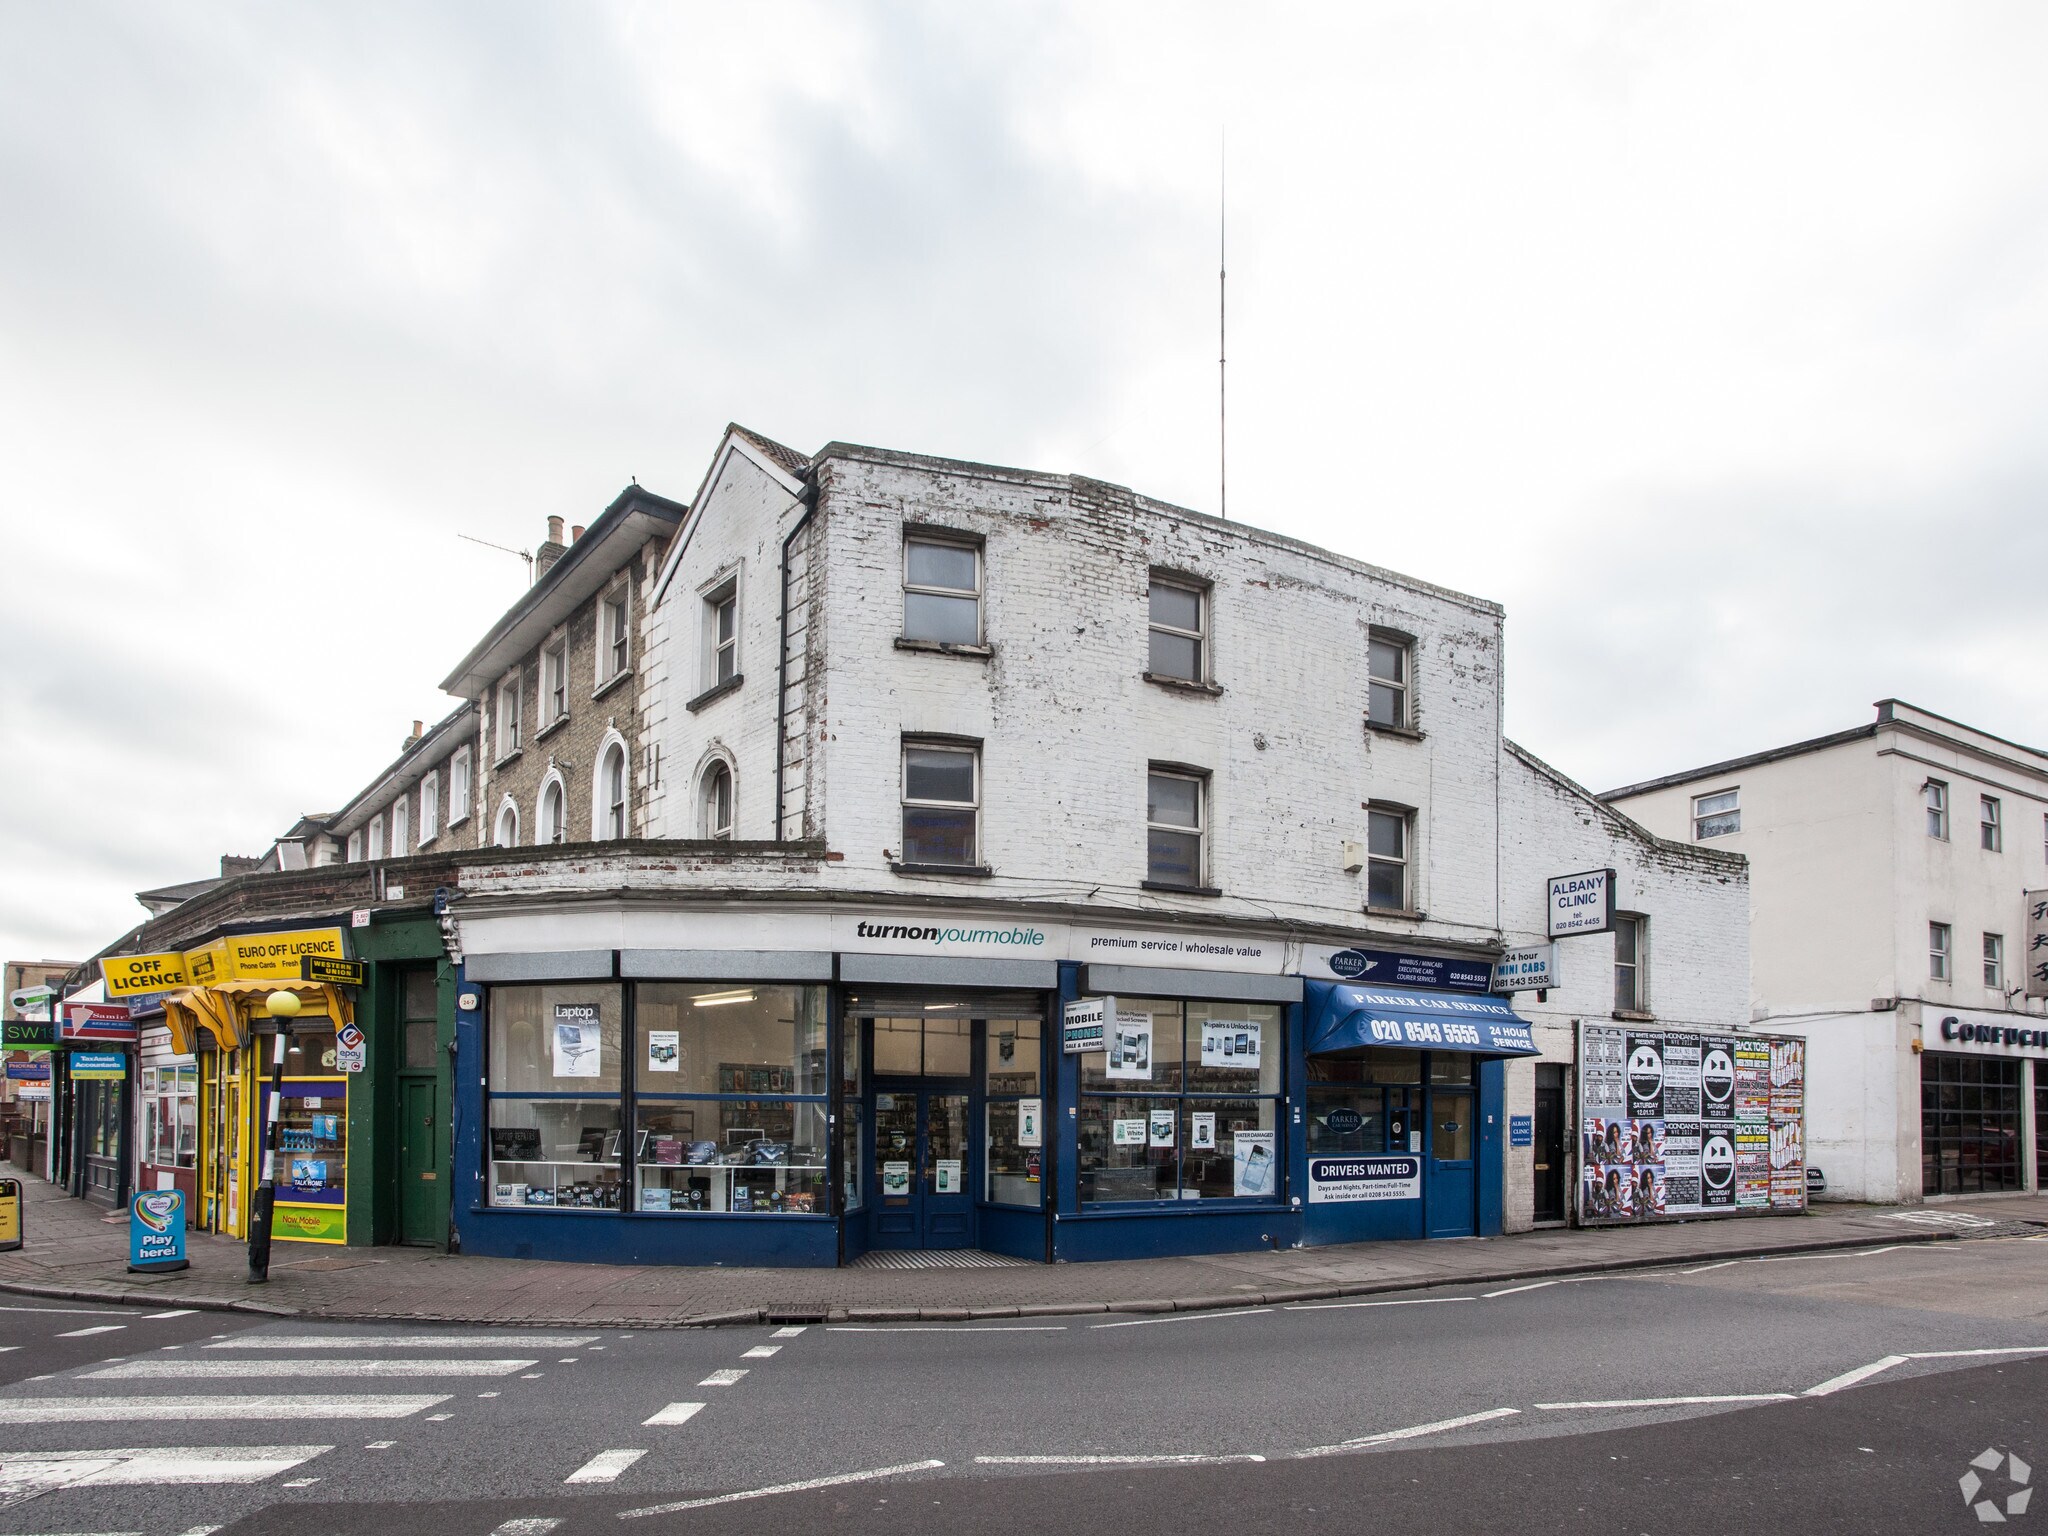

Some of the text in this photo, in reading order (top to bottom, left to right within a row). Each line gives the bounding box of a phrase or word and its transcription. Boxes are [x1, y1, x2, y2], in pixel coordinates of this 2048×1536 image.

[1552, 876, 1604, 896] ALBANY
[1558, 892, 1597, 908] CLINIC
[858, 921, 1044, 946] turnonyourmobile
[238, 941, 335, 958] EURO OFF LICENCE
[1091, 936, 1138, 949] premium
[1141, 940, 1178, 951] service
[1186, 943, 1234, 955] wholesale
[1236, 946, 1262, 957] value
[1334, 956, 1362, 967] PARKER
[1518, 953, 1538, 961] hour
[129, 961, 161, 973] OFF
[313, 961, 352, 970] WESTERN
[1498, 962, 1546, 976] MINI CABS
[113, 972, 184, 989] LICENCE
[1495, 975, 1549, 987] 081 543 5555
[1352, 994, 1512, 1015] PARKER CAR SERVICE
[556, 1006, 593, 1020] Laptop
[1066, 1012, 1103, 1025] MOBILE
[1065, 1027, 1103, 1041] PHONES
[1231, 1023, 1258, 1032] Unlocking
[1371, 1020, 1480, 1045] 020 8543 5555
[1489, 1026, 1529, 1038] 24 HOUR
[1493, 1038, 1533, 1048] SERVICE
[340, 1050, 360, 1059] epay
[1321, 1164, 1410, 1177] DRIVERS WANTED
[299, 1216, 320, 1225] Mobile
[142, 1235, 173, 1245] Play
[140, 1246, 176, 1258] here!
